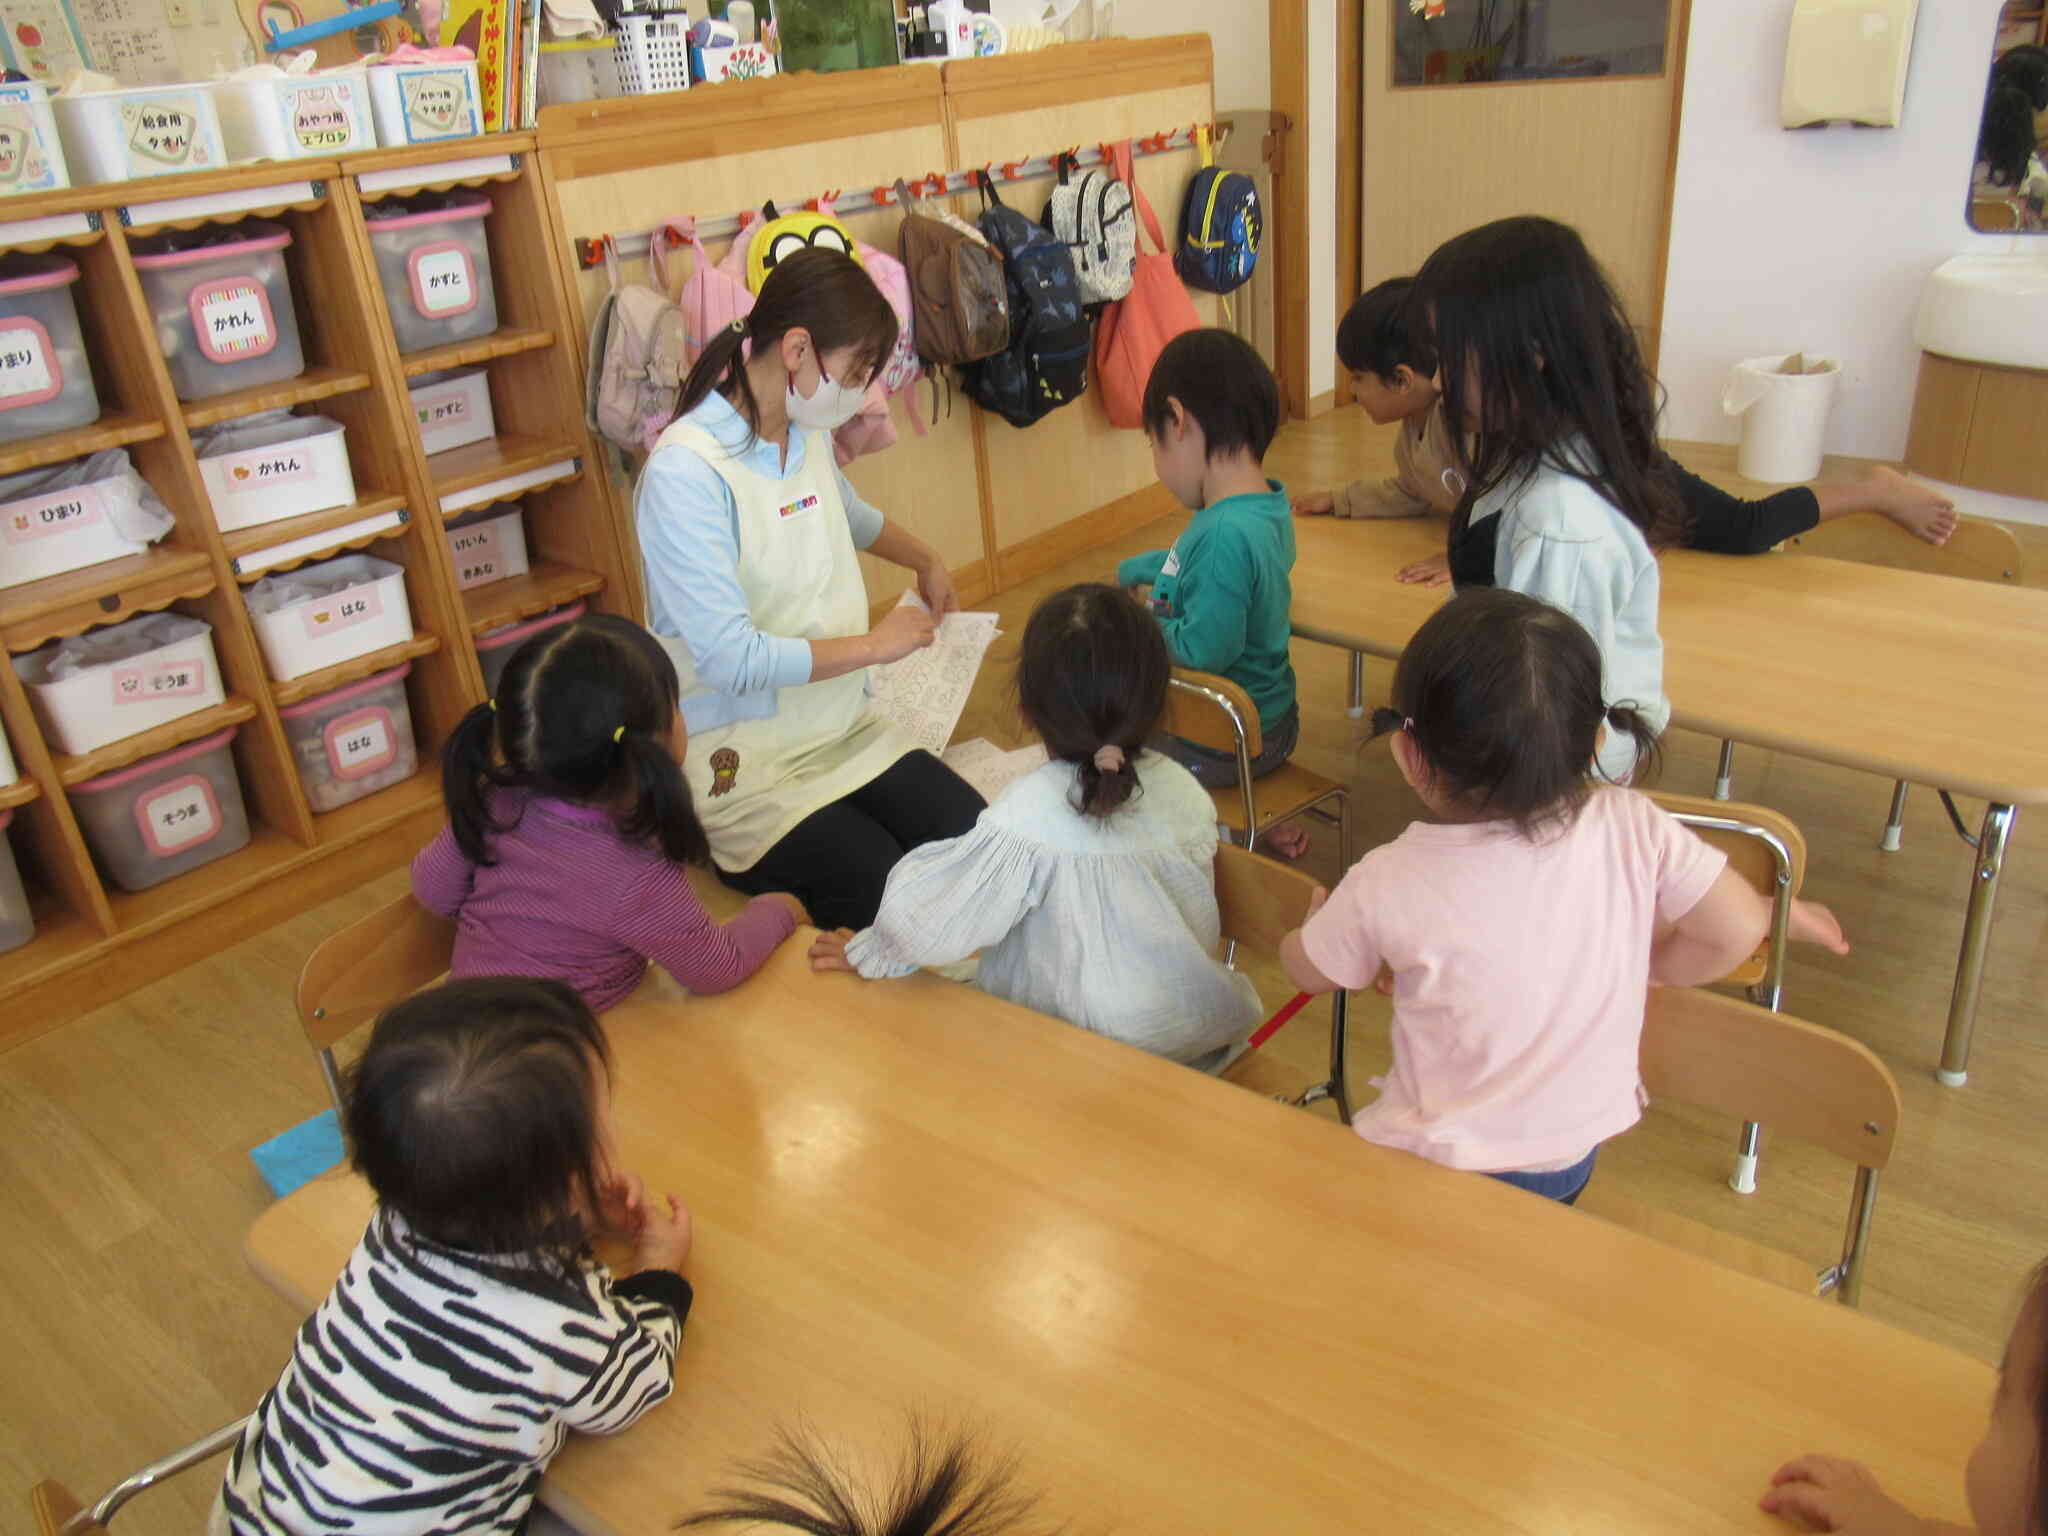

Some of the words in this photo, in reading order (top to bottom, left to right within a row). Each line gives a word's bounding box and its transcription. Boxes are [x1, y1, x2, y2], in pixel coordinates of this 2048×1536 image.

[298, 111, 344, 128] おやつ用
[303, 131, 346, 145] エプロン
[213, 310, 256, 332] かれん
[0, 349, 32, 368] まり
[258, 457, 301, 476] かれん
[40, 500, 82, 523] ひまり
[341, 600, 367, 618] はな
[347, 735, 371, 753] はな
[162, 803, 200, 827] そうま
